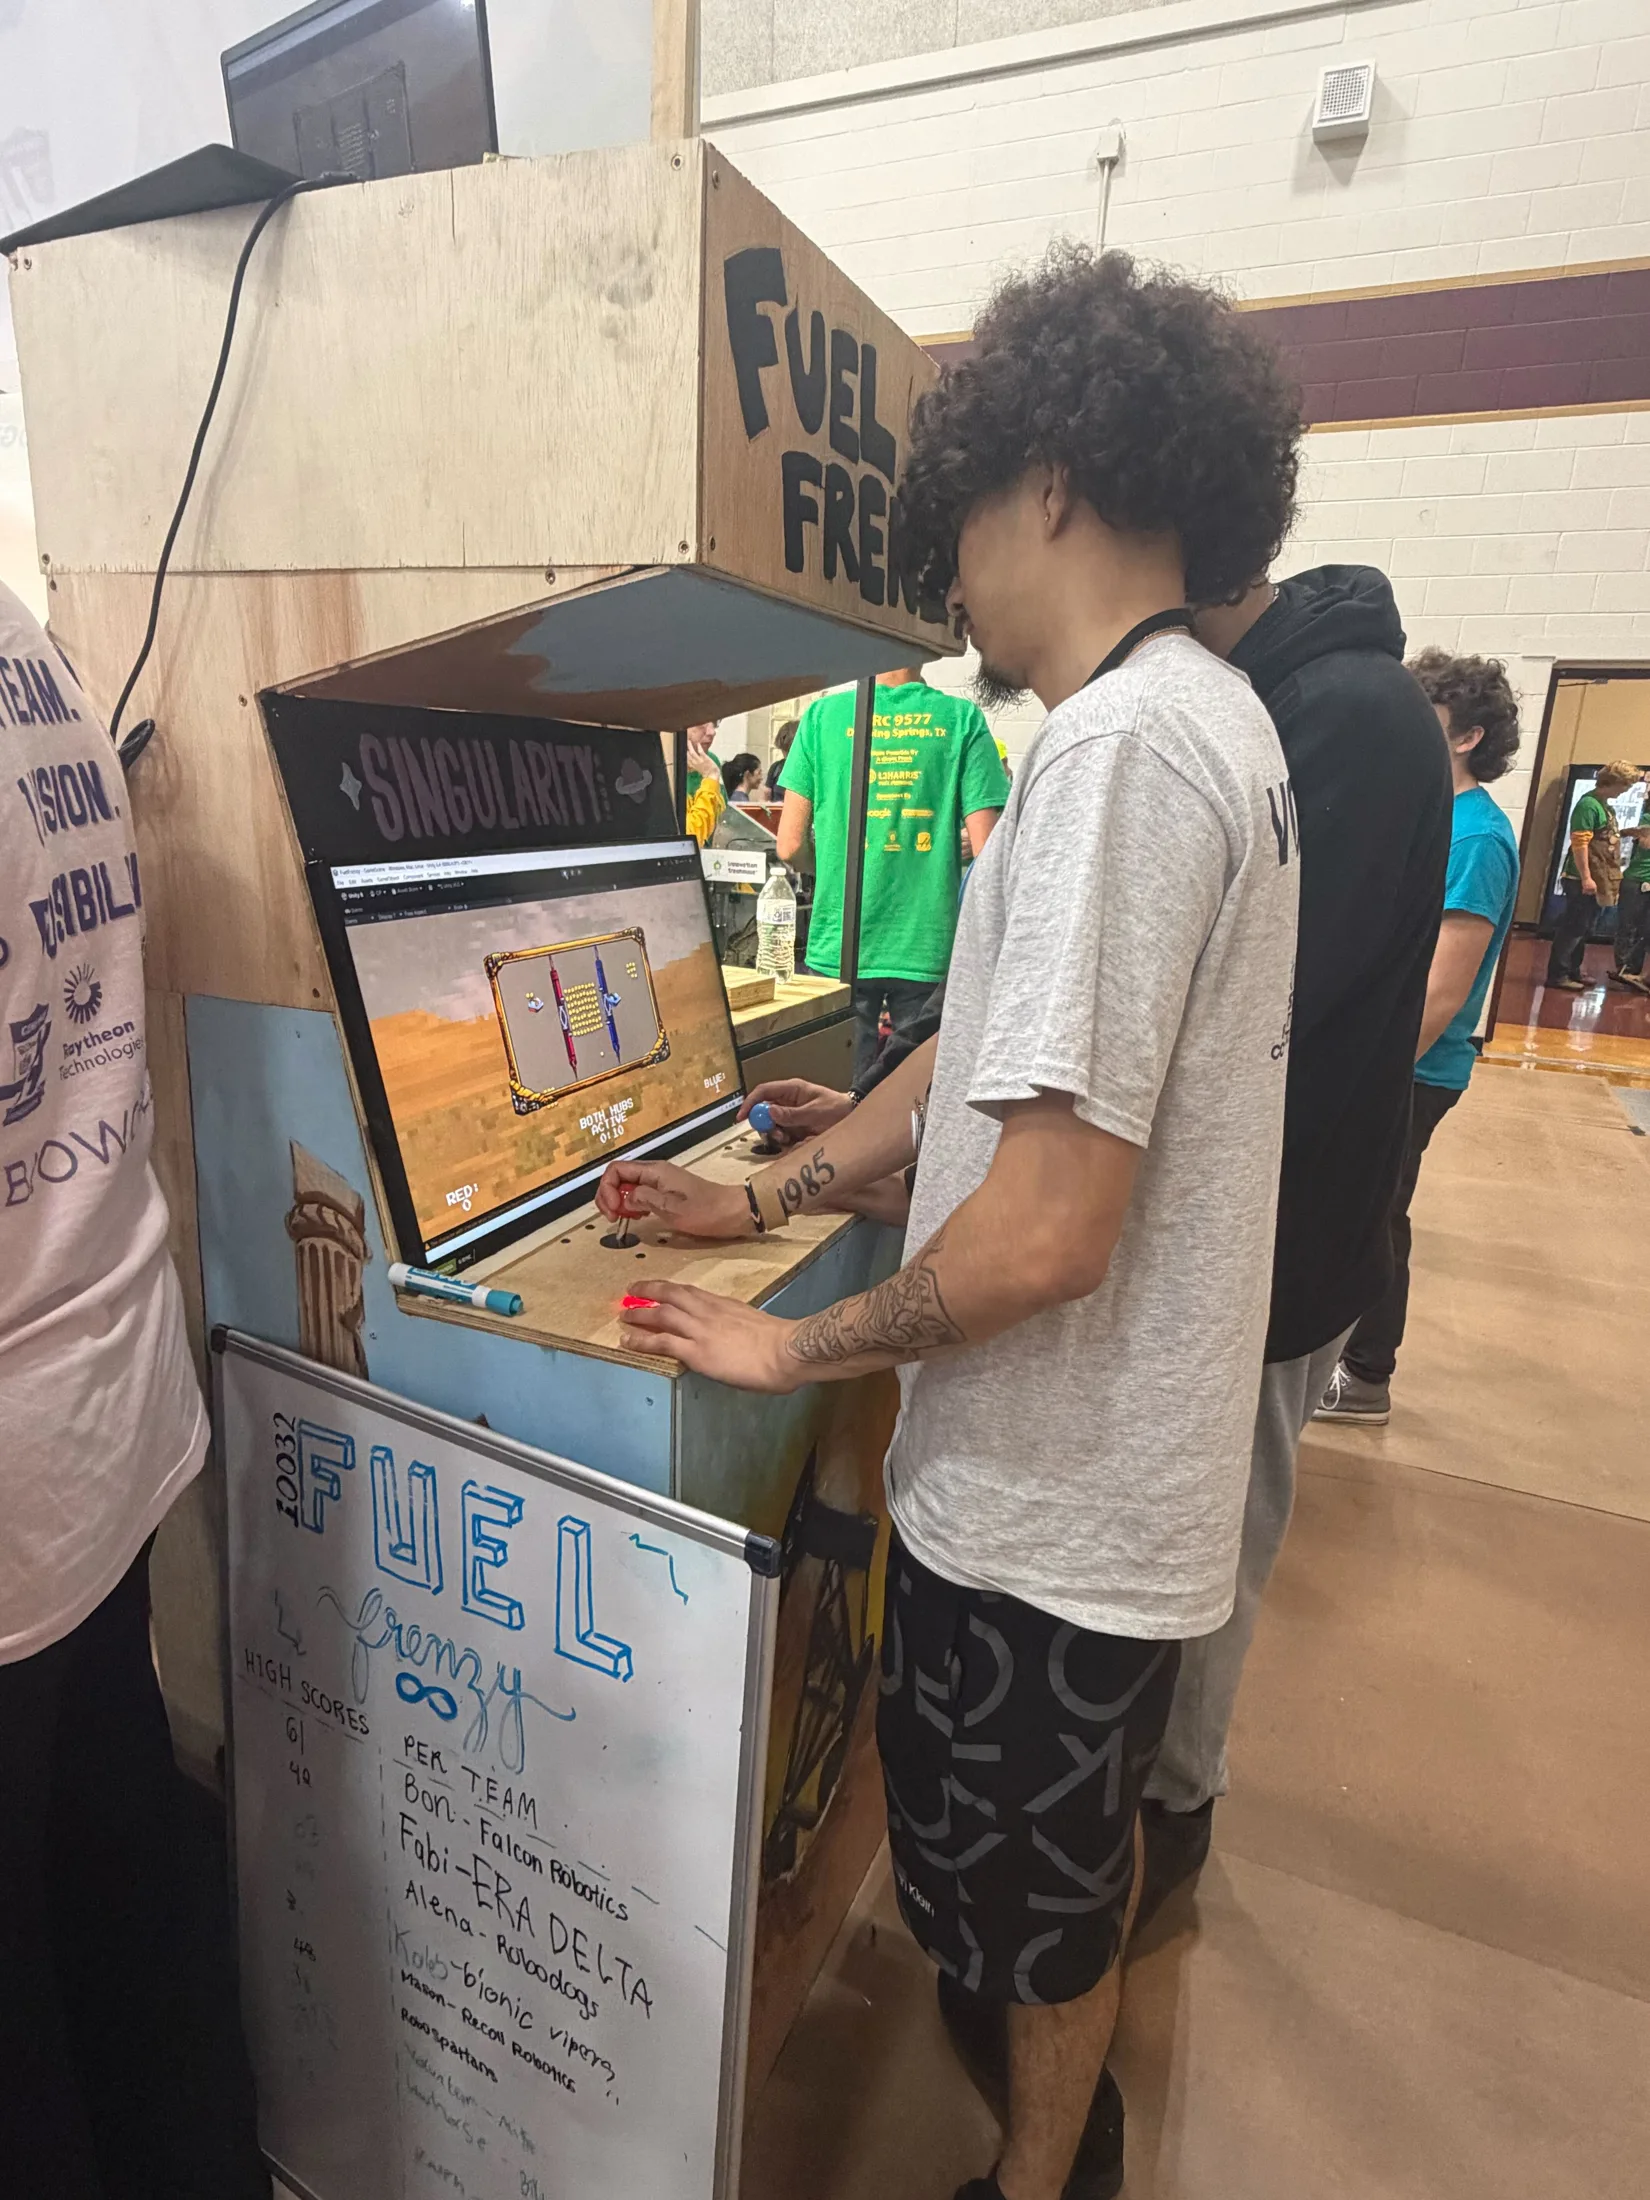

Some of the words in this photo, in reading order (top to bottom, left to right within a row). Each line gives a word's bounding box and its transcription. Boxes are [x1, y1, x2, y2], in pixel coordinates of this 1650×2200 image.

[724, 247, 896, 485] FUEL
[894, 713, 932, 727] 9577
[935, 727, 947, 737] TX
[703, 1072, 726, 1089] BLUE:
[715, 1083, 722, 1094] 1
[579, 1108, 606, 1130] BOTH
[609, 1097, 634, 1117] HUBS
[591, 1111, 628, 1136] ACTIVE
[600, 1124, 624, 1144] 0:10
[445, 1183, 479, 1207] RED:
[461, 1199, 472, 1212] 0
[777, 1147, 835, 1217] 1985
[273, 1412, 299, 1528] 10032
[298, 1418, 634, 1683] FUEL
[246, 1648, 292, 1693] HIGH
[301, 1680, 370, 1736] SCORES
[316, 1586, 576, 1775] frenzy
[404, 1734, 448, 1774] PER
[461, 1765, 538, 1830] TEAM
[480, 1816, 543, 1875] Falcon
[550, 1858, 629, 1921] Robotics
[497, 1933, 600, 2021] Robodogs
[550, 1911, 653, 2020] DELTA
[511, 2041, 577, 2094] Robotics
